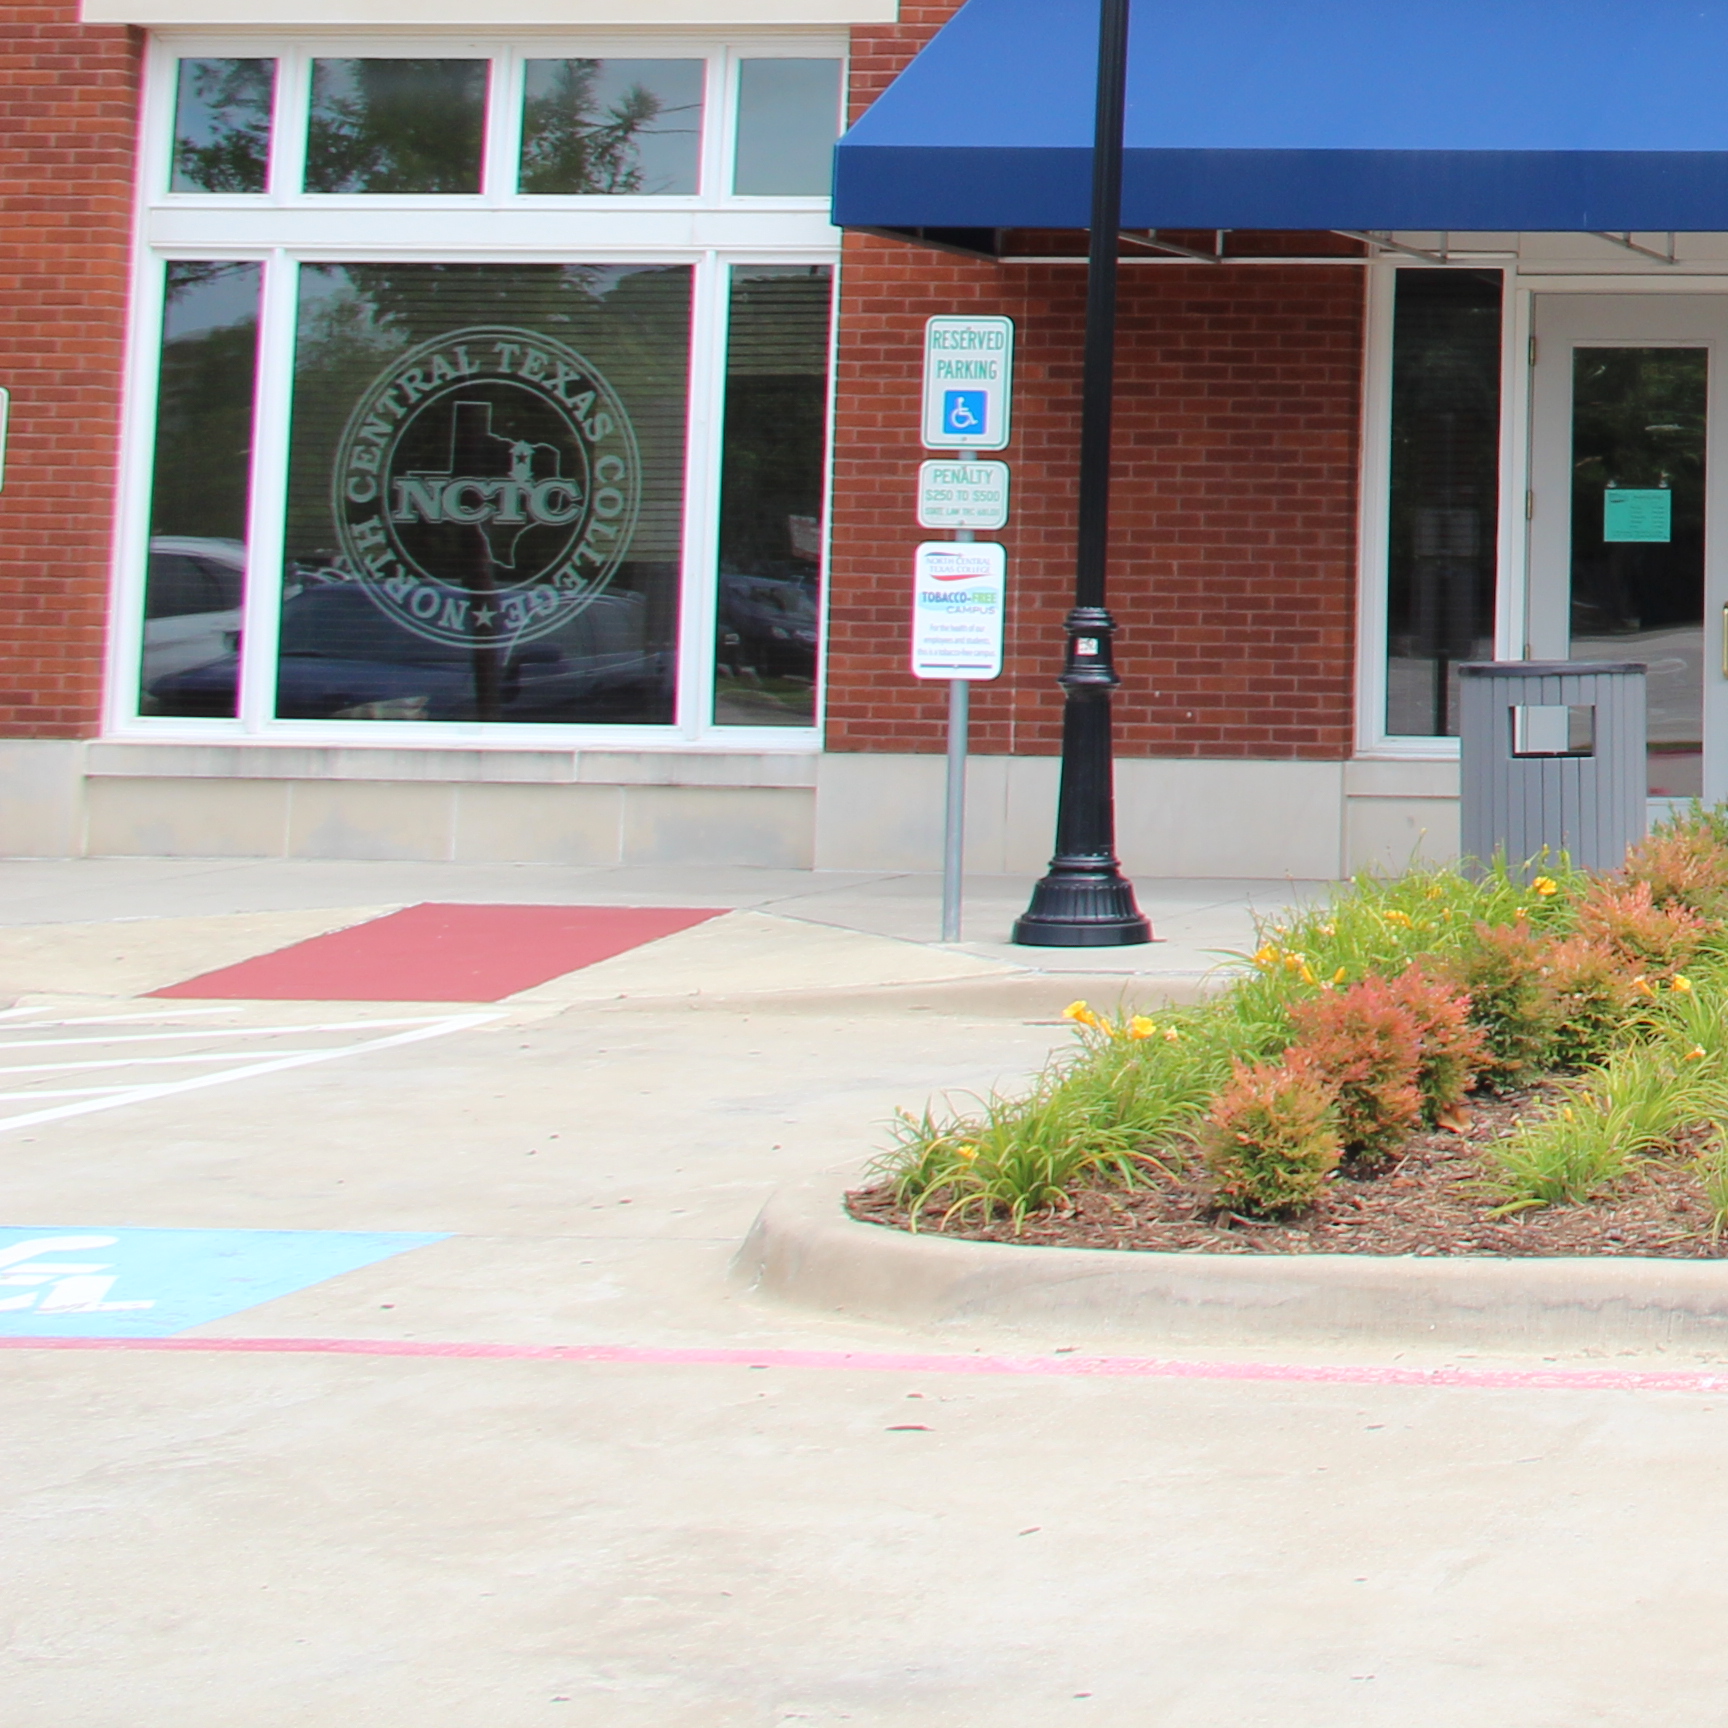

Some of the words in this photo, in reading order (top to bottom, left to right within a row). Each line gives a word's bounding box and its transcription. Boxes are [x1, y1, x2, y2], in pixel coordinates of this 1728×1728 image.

[932, 329, 1004, 351] RESERVED
[936, 359, 998, 380] PARKING
[493, 342, 614, 442] TEXAS
[347, 345, 481, 503] CENTRAL
[933, 468, 994, 484] PENALTY
[392, 476, 584, 525] NCTC
[924, 488, 954, 502] $250
[957, 489, 970, 502] TO
[972, 489, 1001, 502] $500
[501, 454, 626, 629] COLLEGE
[350, 514, 471, 630] NORTH
[922, 590, 998, 604] TOBACCO-FREE
[946, 605, 996, 615] CAMPUS
